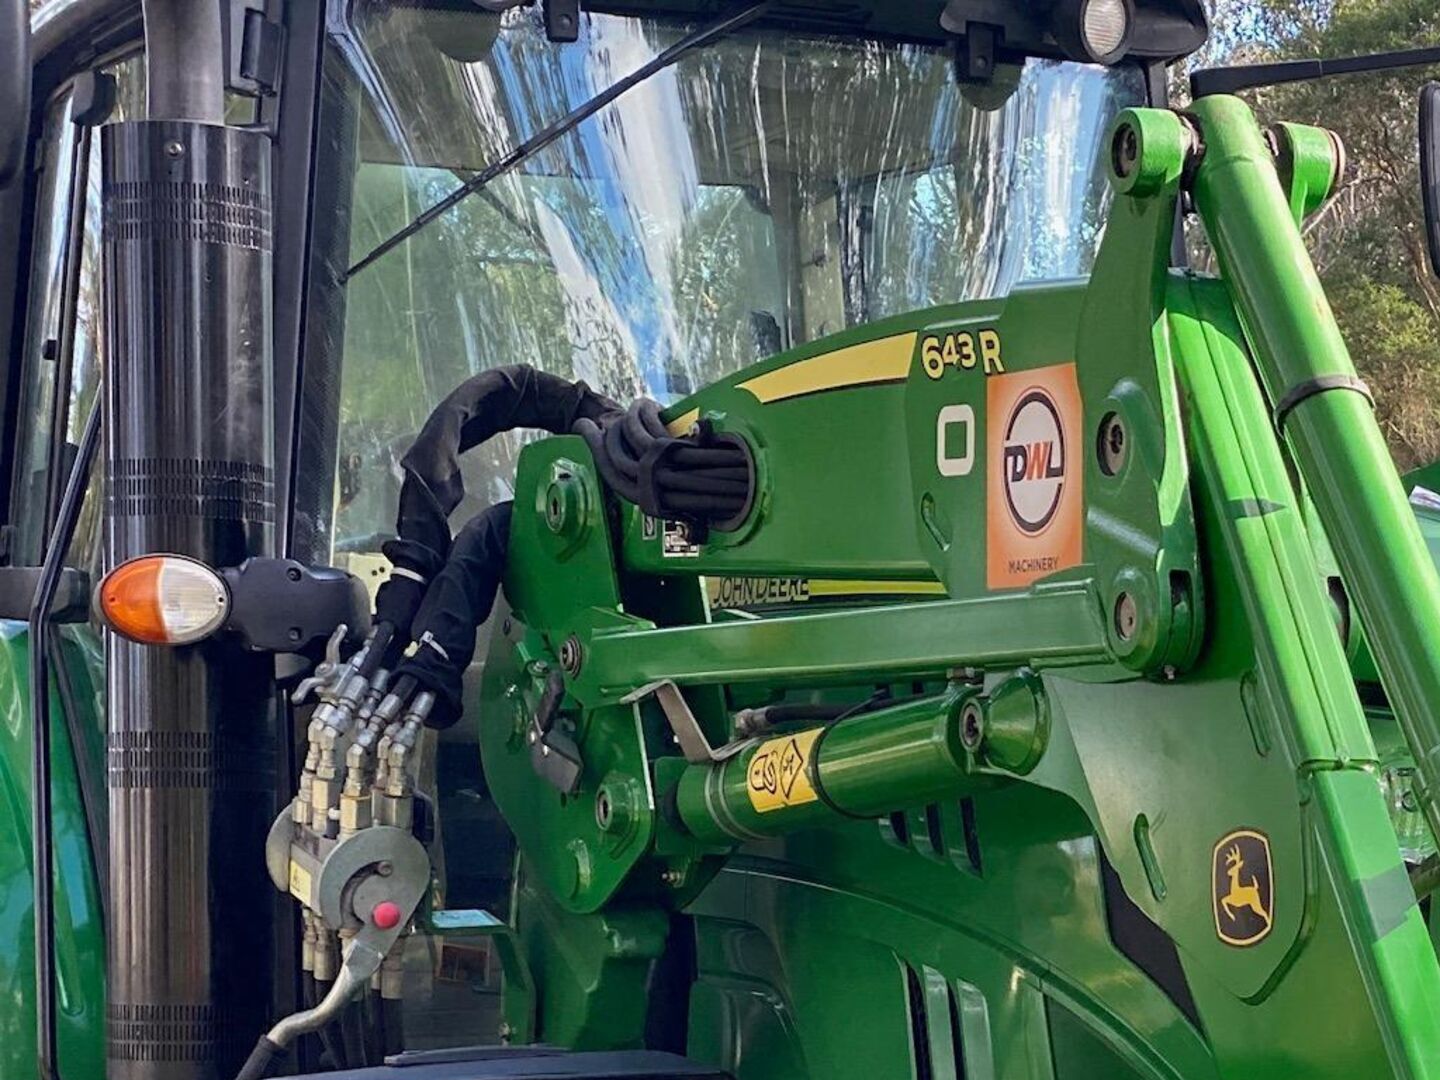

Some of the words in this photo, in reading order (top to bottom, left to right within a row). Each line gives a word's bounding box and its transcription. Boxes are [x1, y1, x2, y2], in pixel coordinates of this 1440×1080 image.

[1003, 441, 1065, 483] DWL
[1008, 556, 1060, 574] MACHINERY
[713, 576, 754, 604] JOHN
